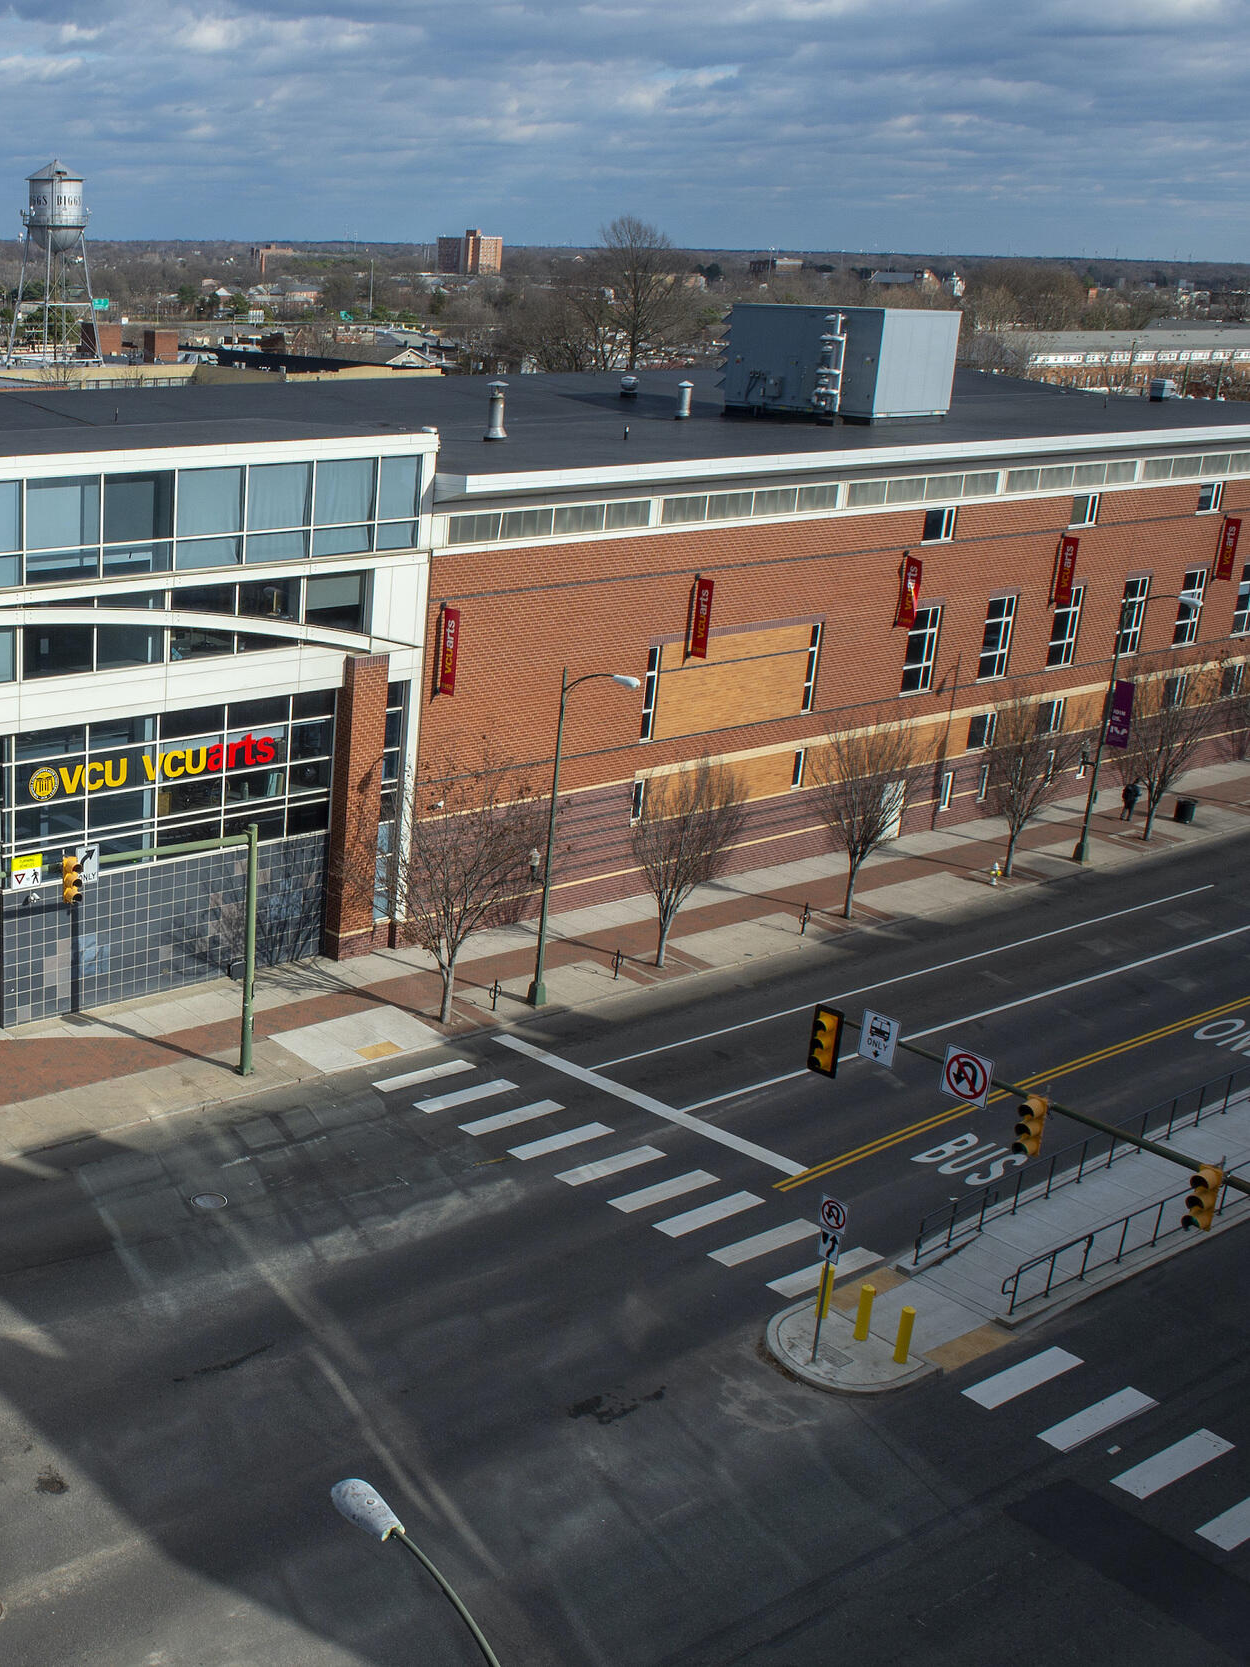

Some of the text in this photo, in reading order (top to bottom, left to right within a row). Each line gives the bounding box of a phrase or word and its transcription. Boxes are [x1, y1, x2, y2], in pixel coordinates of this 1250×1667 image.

[59, 757, 128, 795] VCU
[866, 1037, 887, 1052] ONLY
[910, 1132, 1029, 1186] BUS
